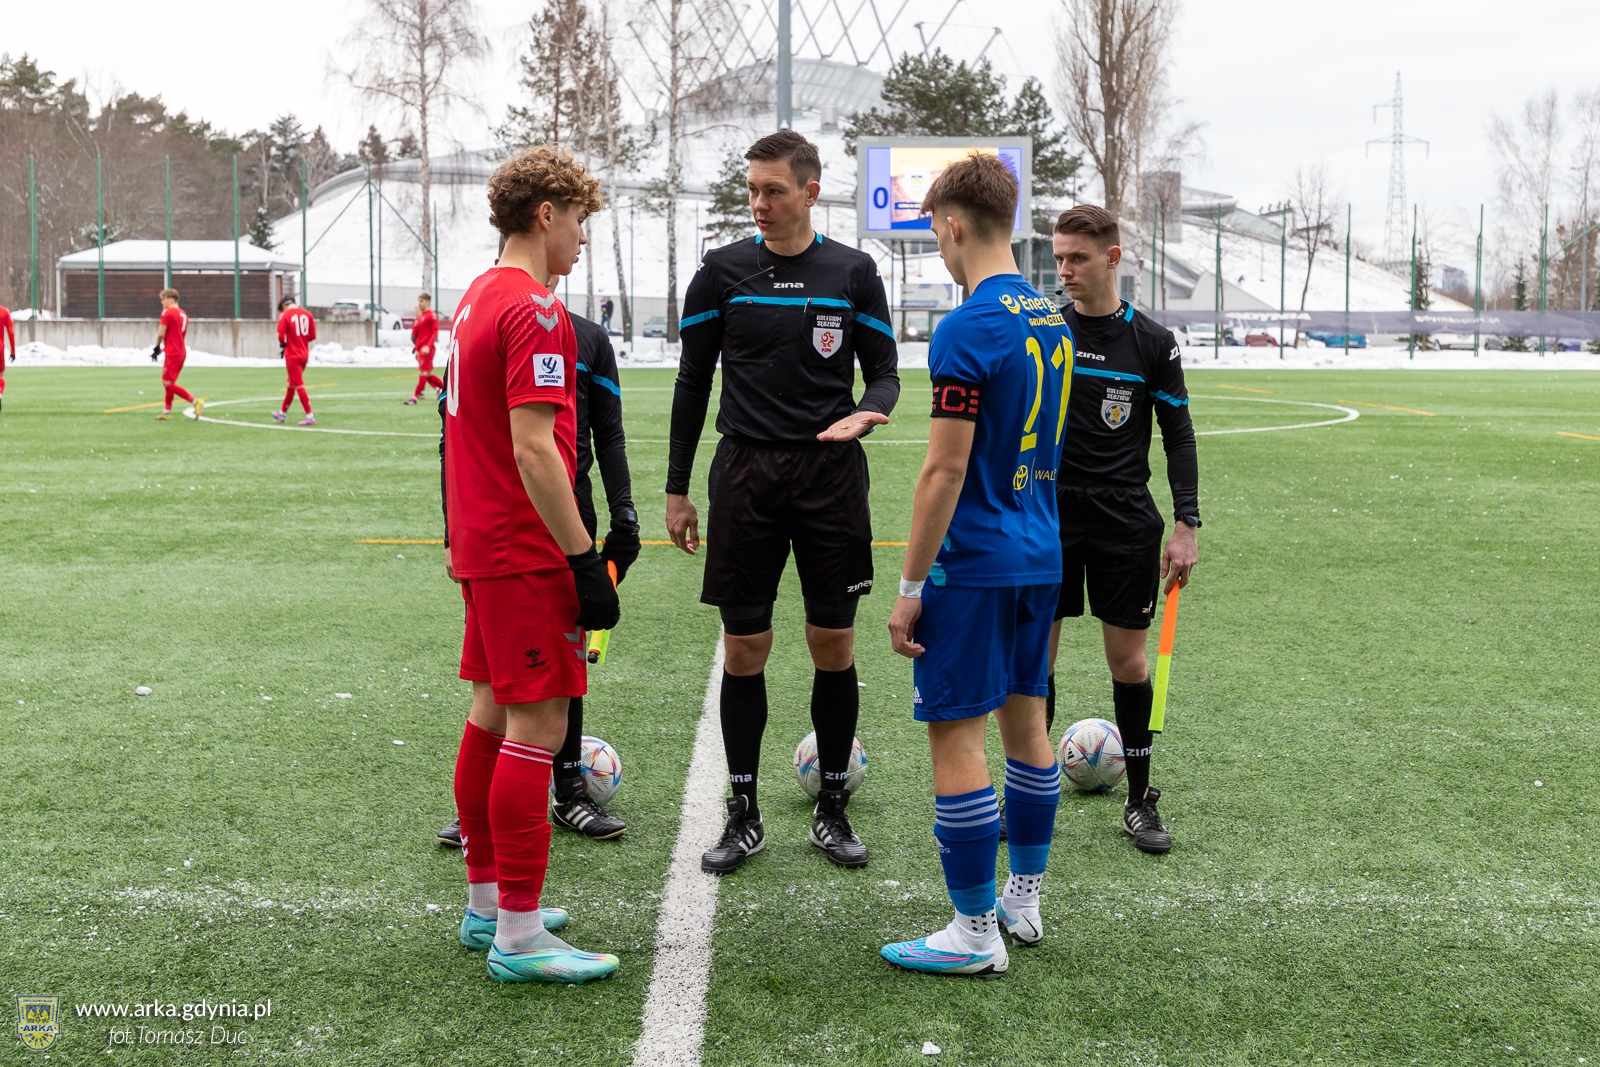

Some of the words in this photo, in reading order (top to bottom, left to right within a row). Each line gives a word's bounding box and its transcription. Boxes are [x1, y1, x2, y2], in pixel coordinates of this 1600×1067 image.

[873, 187, 889, 209] 0
[1018, 295, 1058, 313] Energ
[291, 314, 310, 336] 10
[1076, 350, 1105, 361] zina
[1020, 335, 1074, 452] 21
[1034, 469, 1057, 481] WAL
[847, 579, 873, 593] zina
[825, 771, 848, 780] zin
